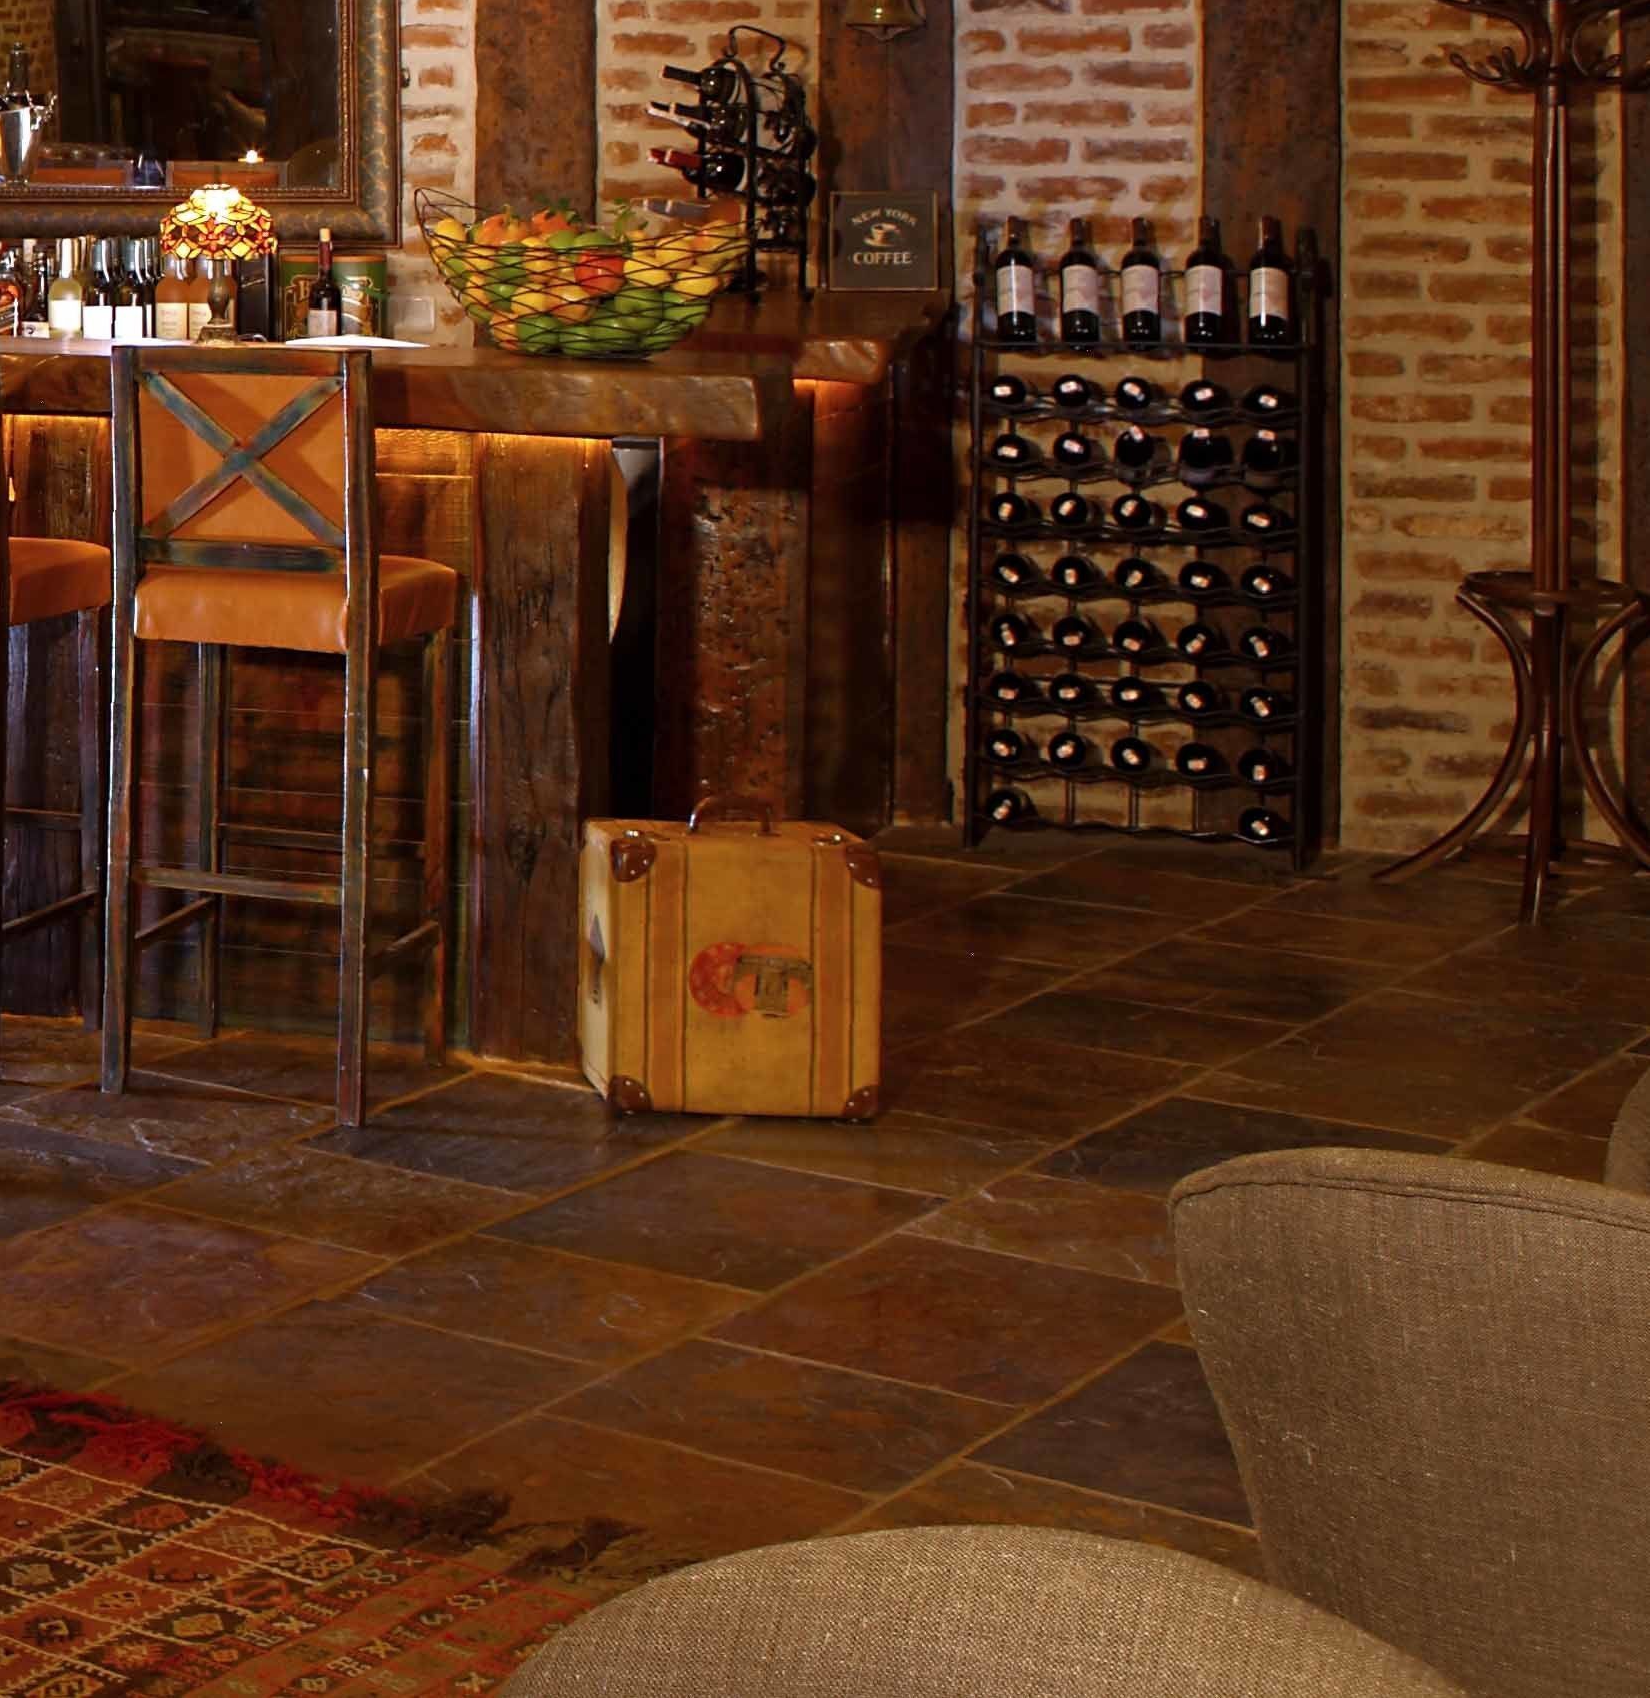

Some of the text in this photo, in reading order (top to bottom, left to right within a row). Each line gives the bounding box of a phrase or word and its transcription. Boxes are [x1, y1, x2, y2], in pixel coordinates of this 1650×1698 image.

[851, 208, 918, 228] NEW YORK
[853, 251, 912, 265] COFFEE
